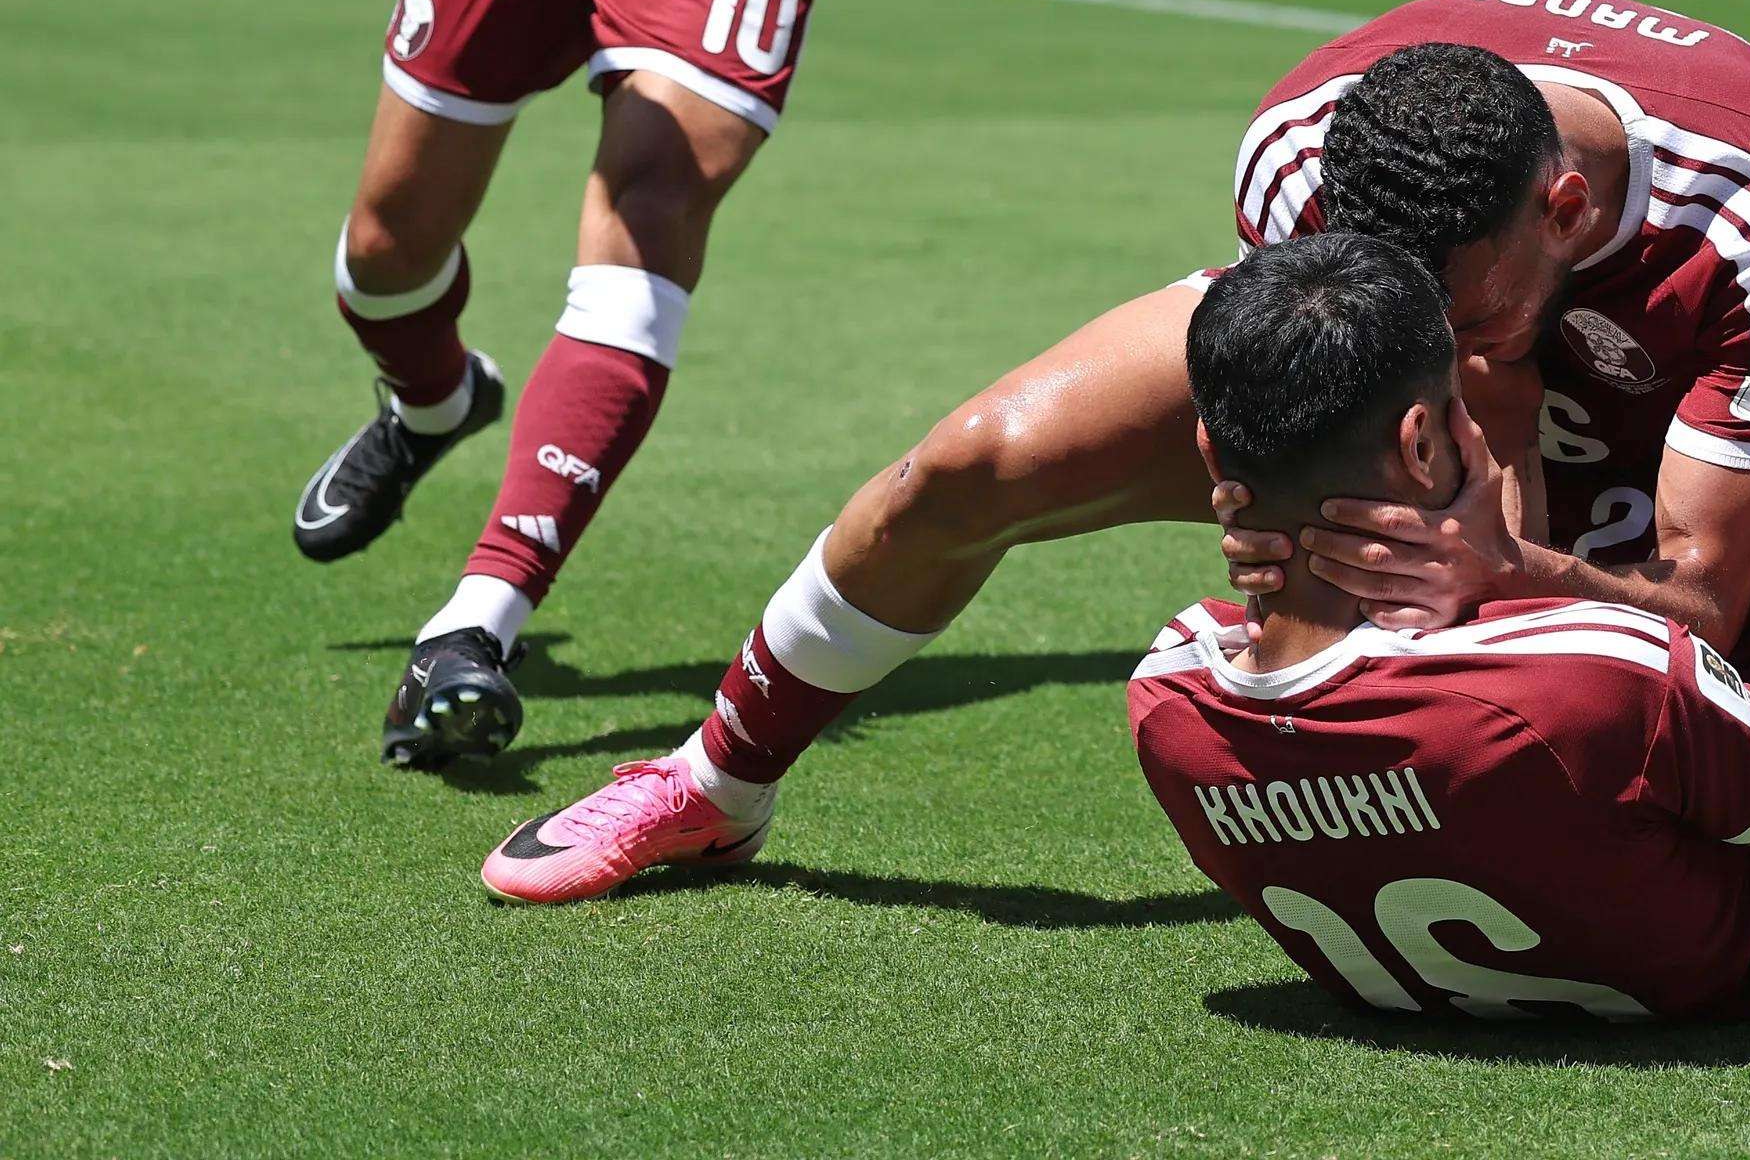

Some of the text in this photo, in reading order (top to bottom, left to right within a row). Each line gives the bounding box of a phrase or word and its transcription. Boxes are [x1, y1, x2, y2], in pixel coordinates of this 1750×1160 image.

[1593, 359, 1639, 381] QFA
[536, 443, 601, 494] QFA
[1195, 766, 1441, 846] KHOUKHI
[1262, 877, 1656, 1023] 16
